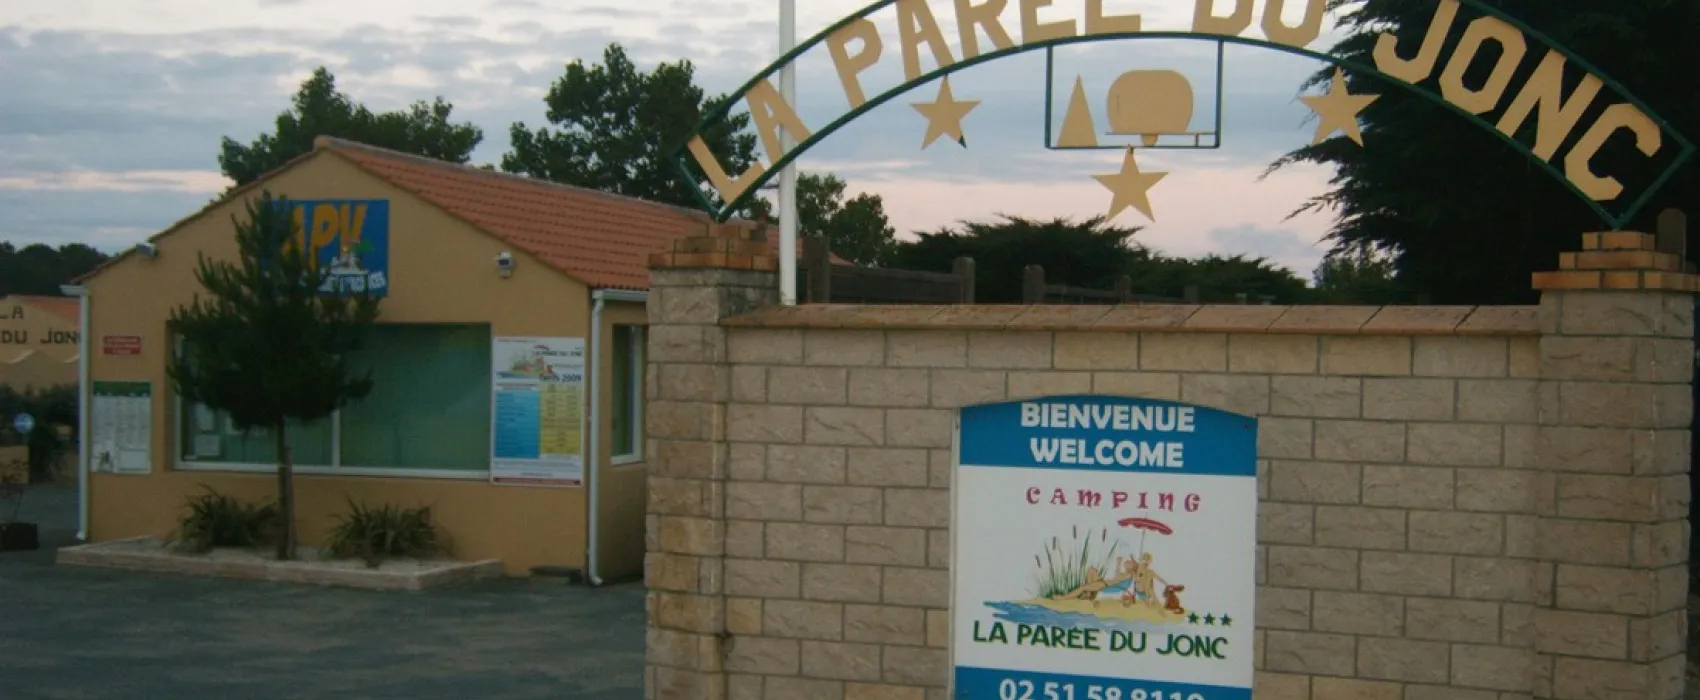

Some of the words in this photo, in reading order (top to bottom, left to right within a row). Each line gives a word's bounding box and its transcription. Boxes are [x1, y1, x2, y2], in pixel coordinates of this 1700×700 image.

[687, 78, 811, 204] LA
[1373, 0, 1661, 201] JONC
[1, 330, 27, 344] DU
[40, 328, 80, 344] JON
[1020, 402, 1196, 432] BIENVENUE
[1029, 437, 1184, 468] WELCOME
[1026, 487, 1201, 512] CAMPING
[973, 620, 1008, 644] LA
[1016, 624, 1100, 650] PARÉE
[1110, 630, 1146, 653] DU
[1156, 633, 1228, 659] JONC
[999, 678, 1035, 700] 02
[1043, 681, 1075, 700] 51
[1087, 684, 1122, 700] 58
